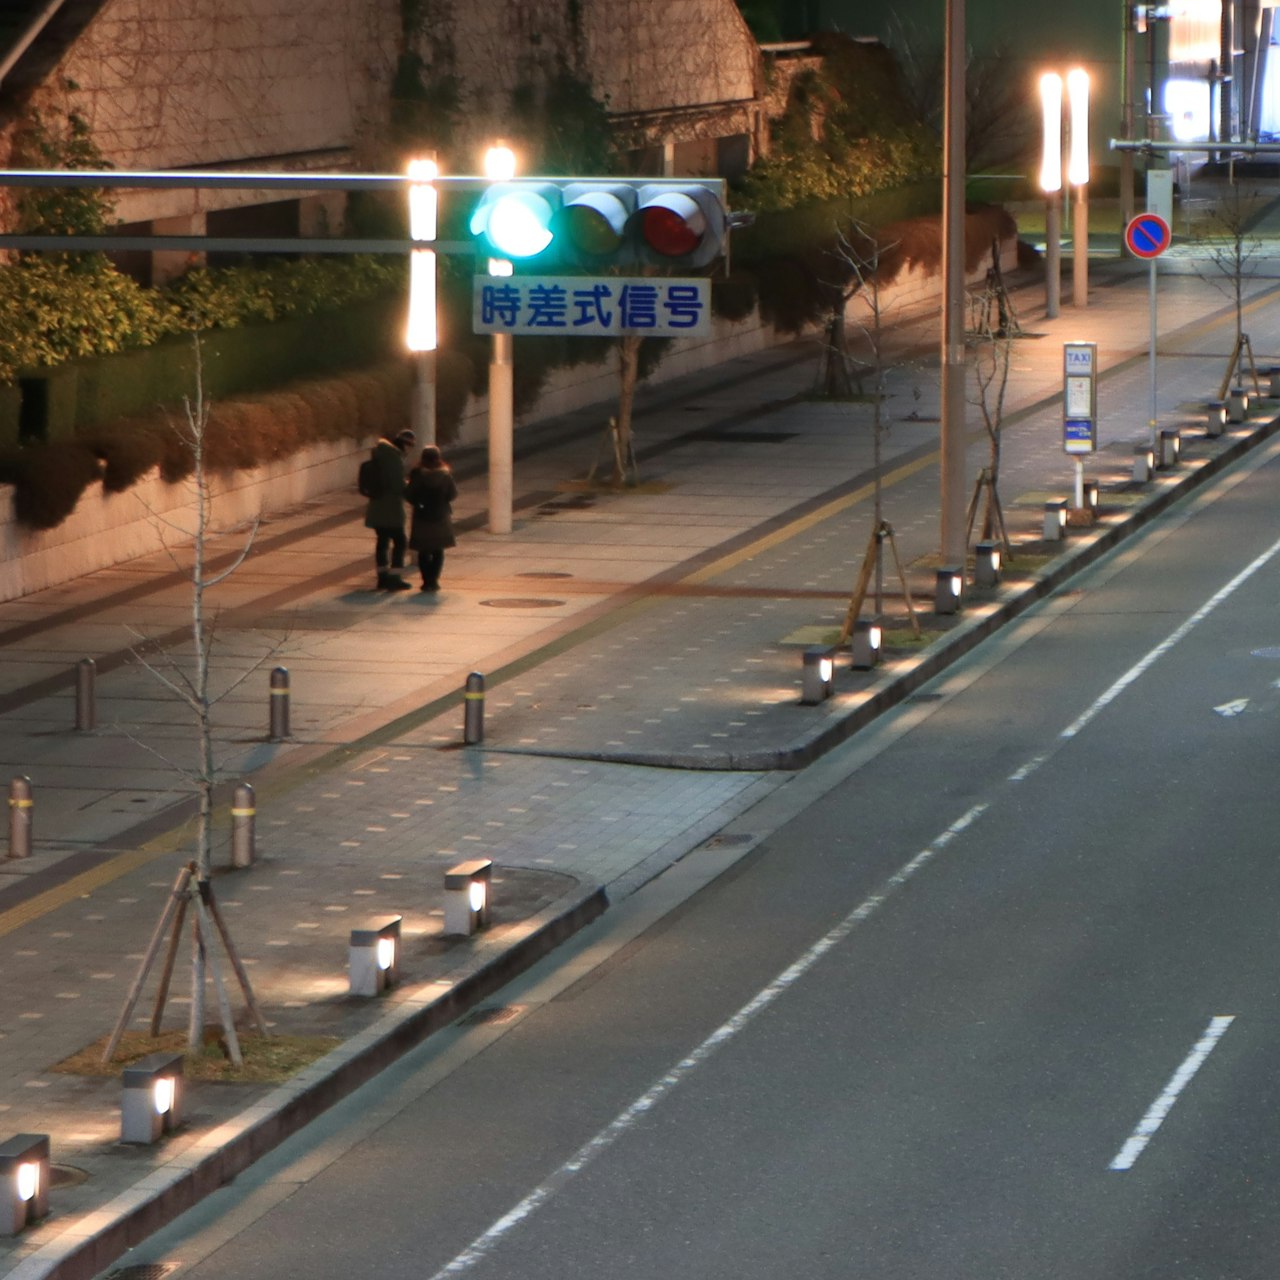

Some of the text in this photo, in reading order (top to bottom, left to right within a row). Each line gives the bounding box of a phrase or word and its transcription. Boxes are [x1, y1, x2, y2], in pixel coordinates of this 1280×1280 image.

[481, 284, 704, 329] 時差式信号
[1067, 352, 1091, 363] TAXI
